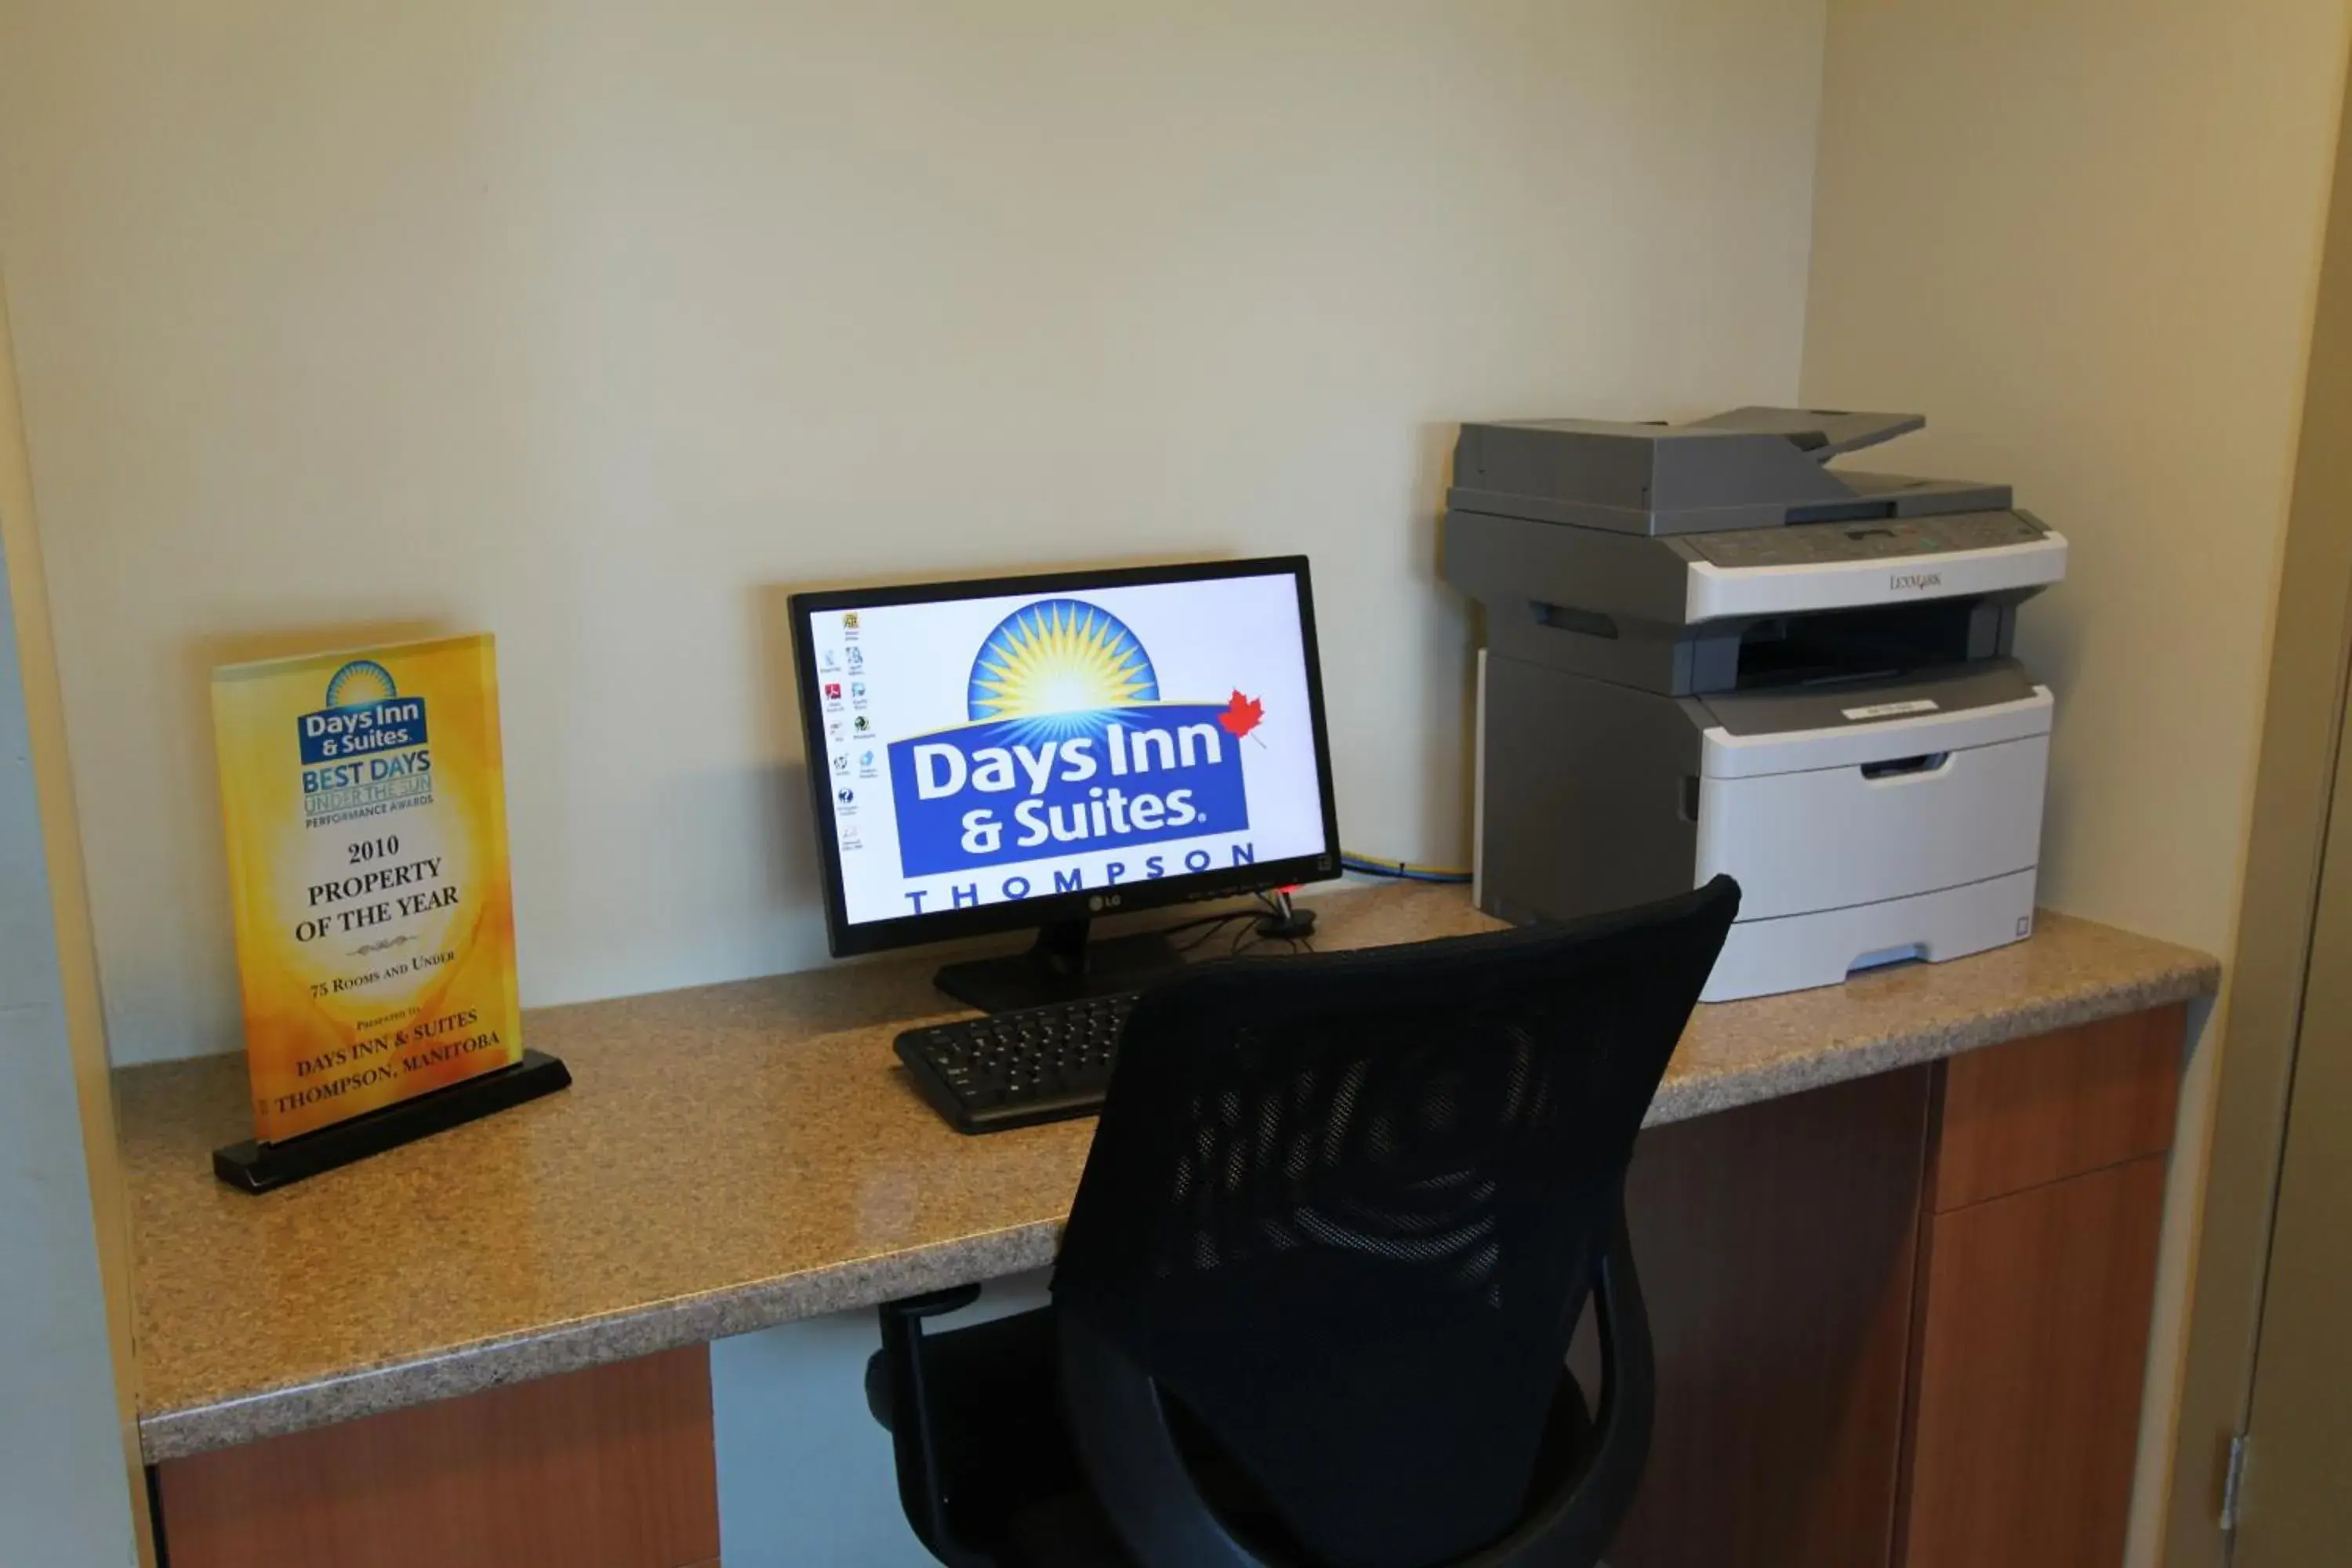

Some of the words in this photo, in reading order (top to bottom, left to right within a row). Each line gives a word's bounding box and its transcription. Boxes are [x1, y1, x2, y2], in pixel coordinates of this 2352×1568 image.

[1889, 573, 1942, 591] LEXMARK
[305, 710, 373, 738] Days
[376, 702, 419, 726] Inn
[322, 739, 338, 757] &
[341, 727, 409, 753] Suites
[301, 760, 365, 794] BEST
[370, 749, 431, 782] DAYS
[913, 734, 1098, 800] Days
[1106, 721, 1222, 775] Inn
[304, 786, 363, 815] UNDER
[365, 781, 396, 806] THE
[398, 773, 431, 797] SUN
[305, 803, 387, 829] PERFORMANCE
[389, 793, 434, 812] AWARDS
[348, 834, 400, 864] 2010
[960, 808, 1003, 854] &
[307, 856, 442, 907] PROPERTY
[904, 842, 1254, 915] THOMPSON
[295, 915, 332, 942] OF
[336, 901, 392, 933] THE
[396, 885, 459, 918] YEAR
[310, 982, 328, 999] 75
[296, 1047, 348, 1077] DAYS
[351, 1034, 389, 1061] INN
[394, 1029, 409, 1048] &
[412, 1007, 478, 1040] SUITES
[274, 1062, 398, 1114] THOMPSON,
[402, 1029, 501, 1072] MANITOBA
